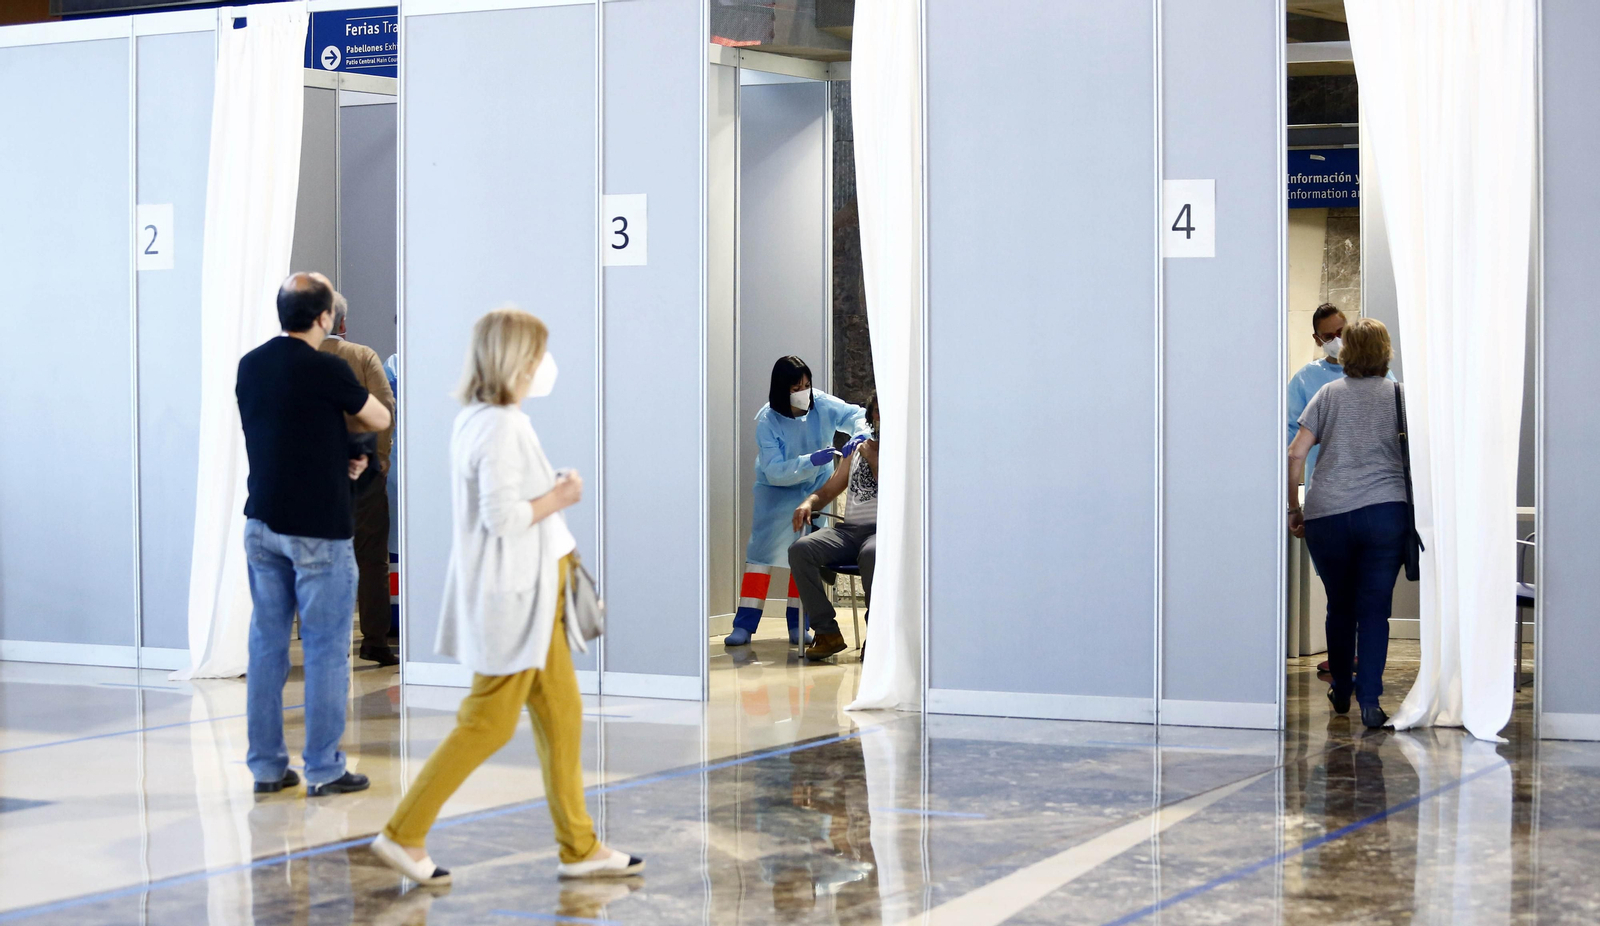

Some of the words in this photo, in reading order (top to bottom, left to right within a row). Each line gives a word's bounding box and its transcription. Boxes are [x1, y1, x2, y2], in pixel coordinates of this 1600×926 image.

[346, 22, 380, 36] Ferias
[382, 21, 398, 34] Tra
[346, 44, 382, 54] Pabellones
[1287, 172, 1351, 184] Información
[1355, 174, 1360, 185] y
[1287, 188, 1348, 200] Information
[1172, 204, 1196, 240] 4
[144, 224, 158, 254] 2
[612, 216, 630, 250] 3
